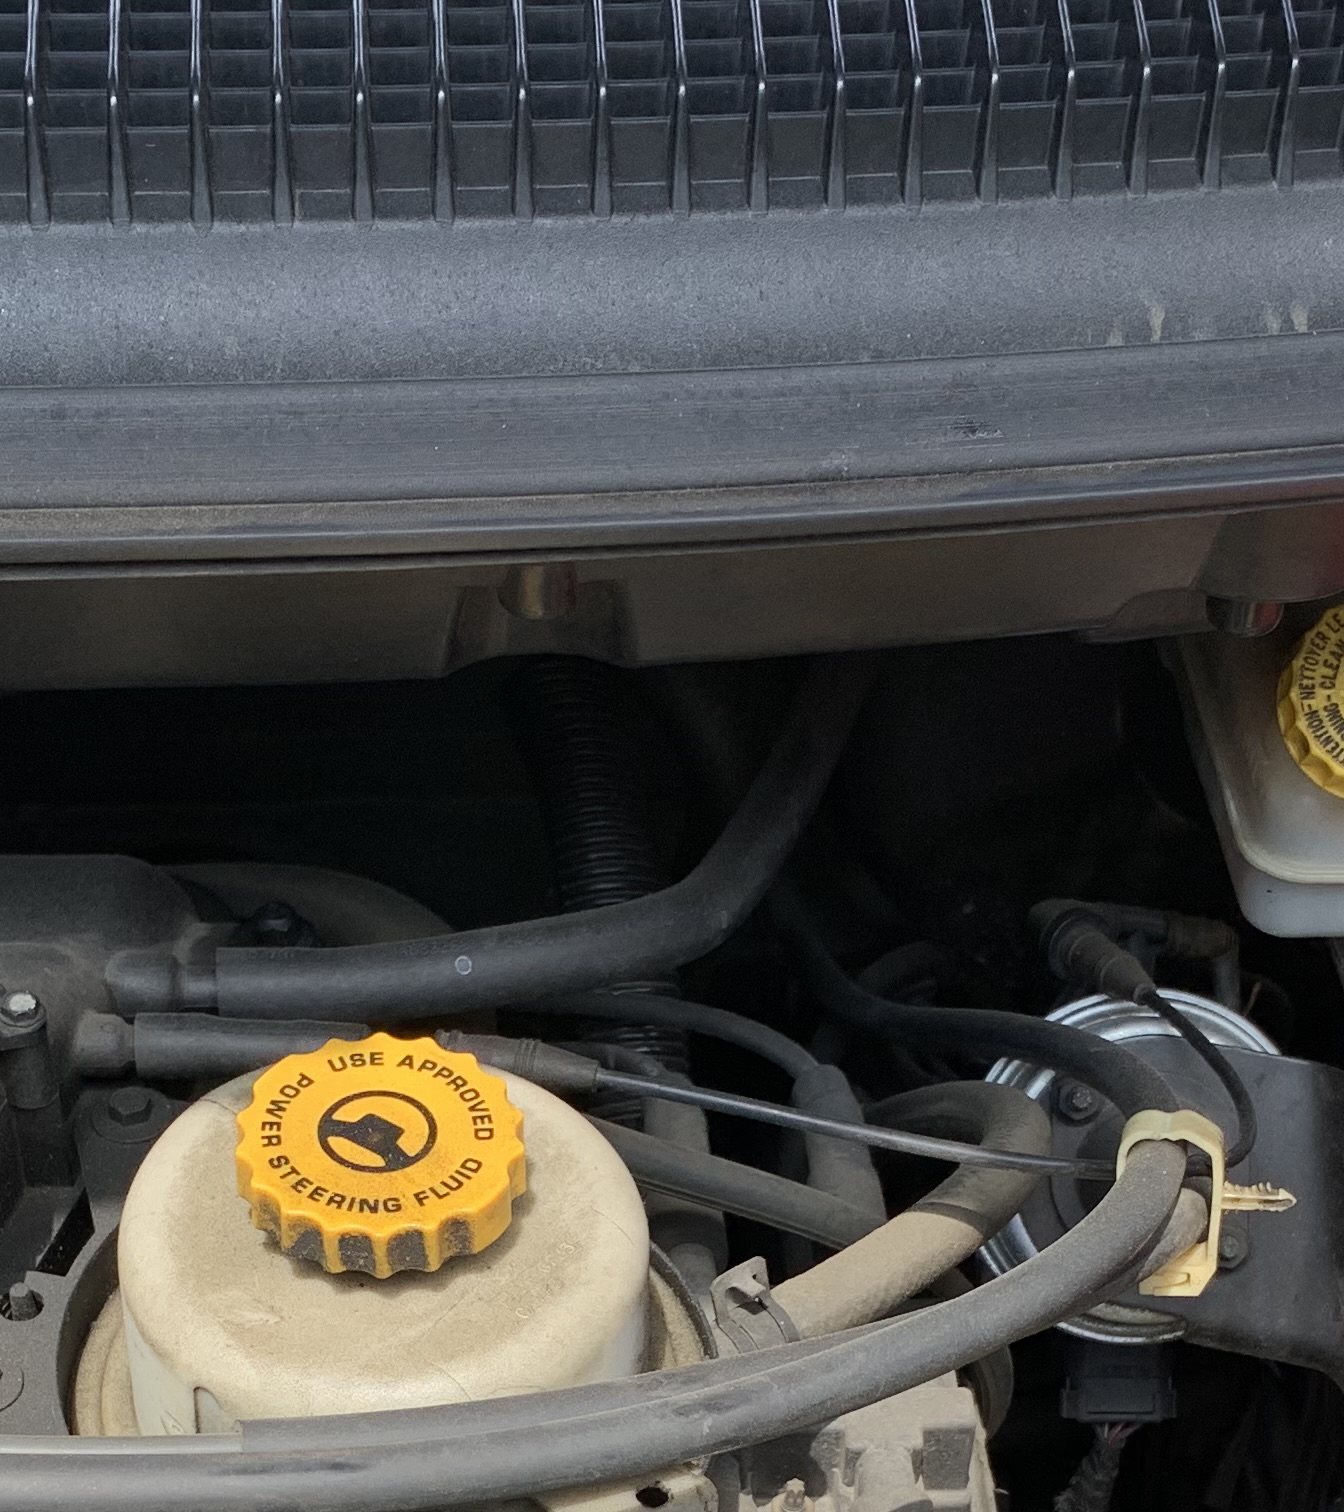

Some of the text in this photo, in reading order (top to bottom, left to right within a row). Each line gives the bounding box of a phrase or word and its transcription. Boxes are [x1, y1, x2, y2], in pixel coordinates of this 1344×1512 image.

[1326, 613, 1344, 633] LE
[327, 1052, 494, 1141] USE APPROVED
[261, 1072, 483, 1214] POWER STEERING FLUID
